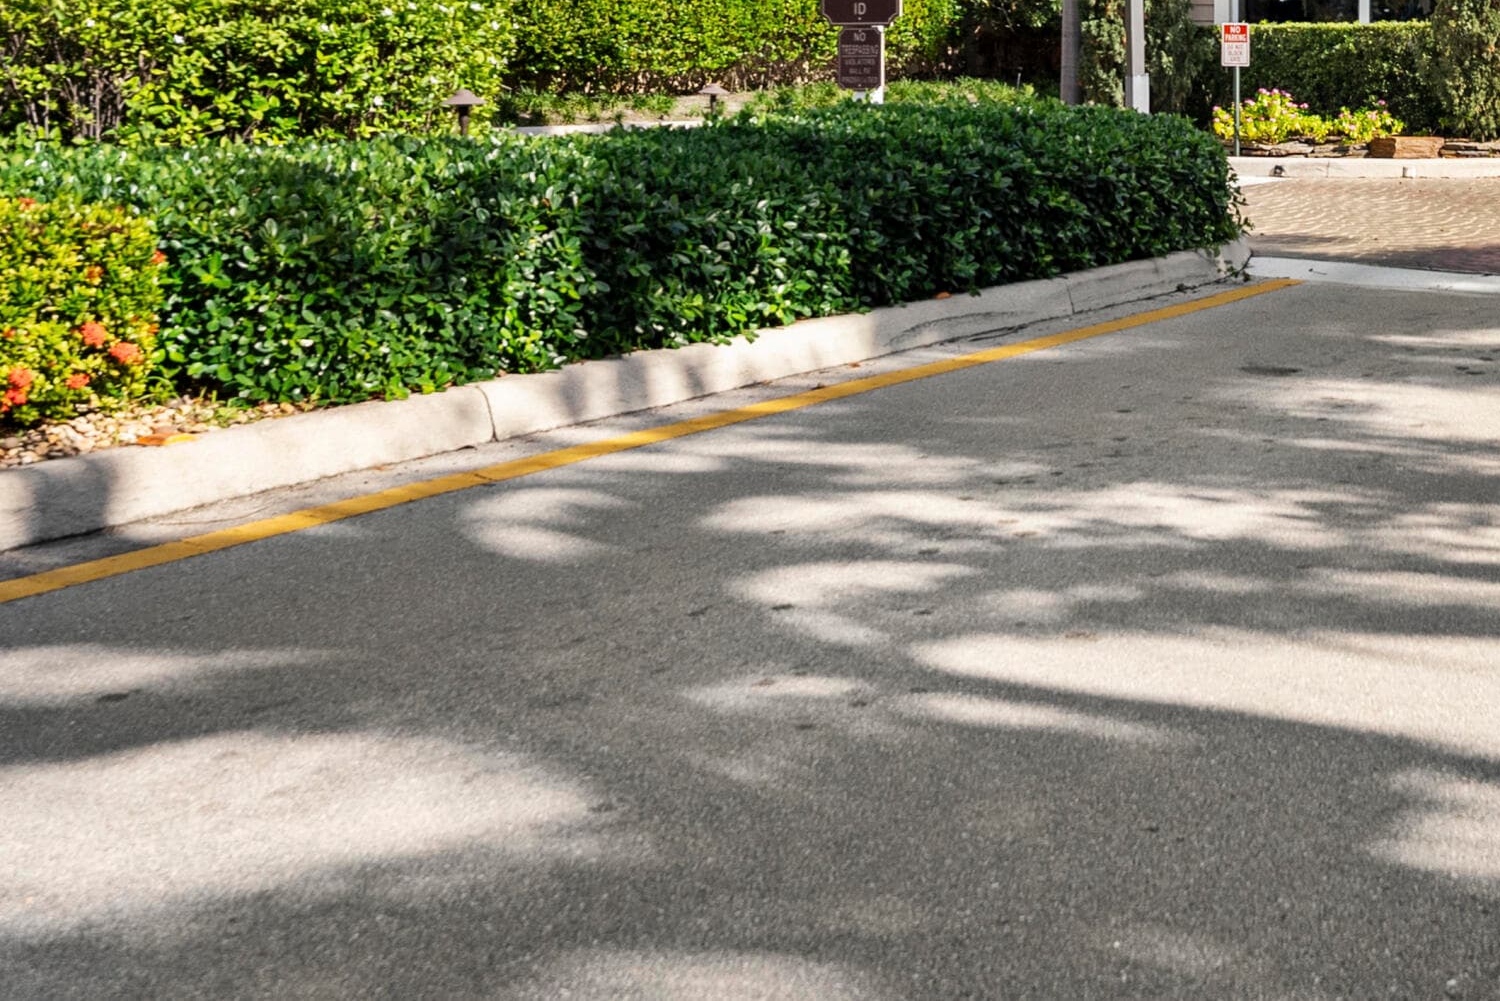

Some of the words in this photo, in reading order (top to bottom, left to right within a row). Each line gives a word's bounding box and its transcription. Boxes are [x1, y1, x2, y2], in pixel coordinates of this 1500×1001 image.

[853, 2, 867, 16] ID
[1230, 26, 1242, 34] NO
[853, 32, 867, 42] NO
